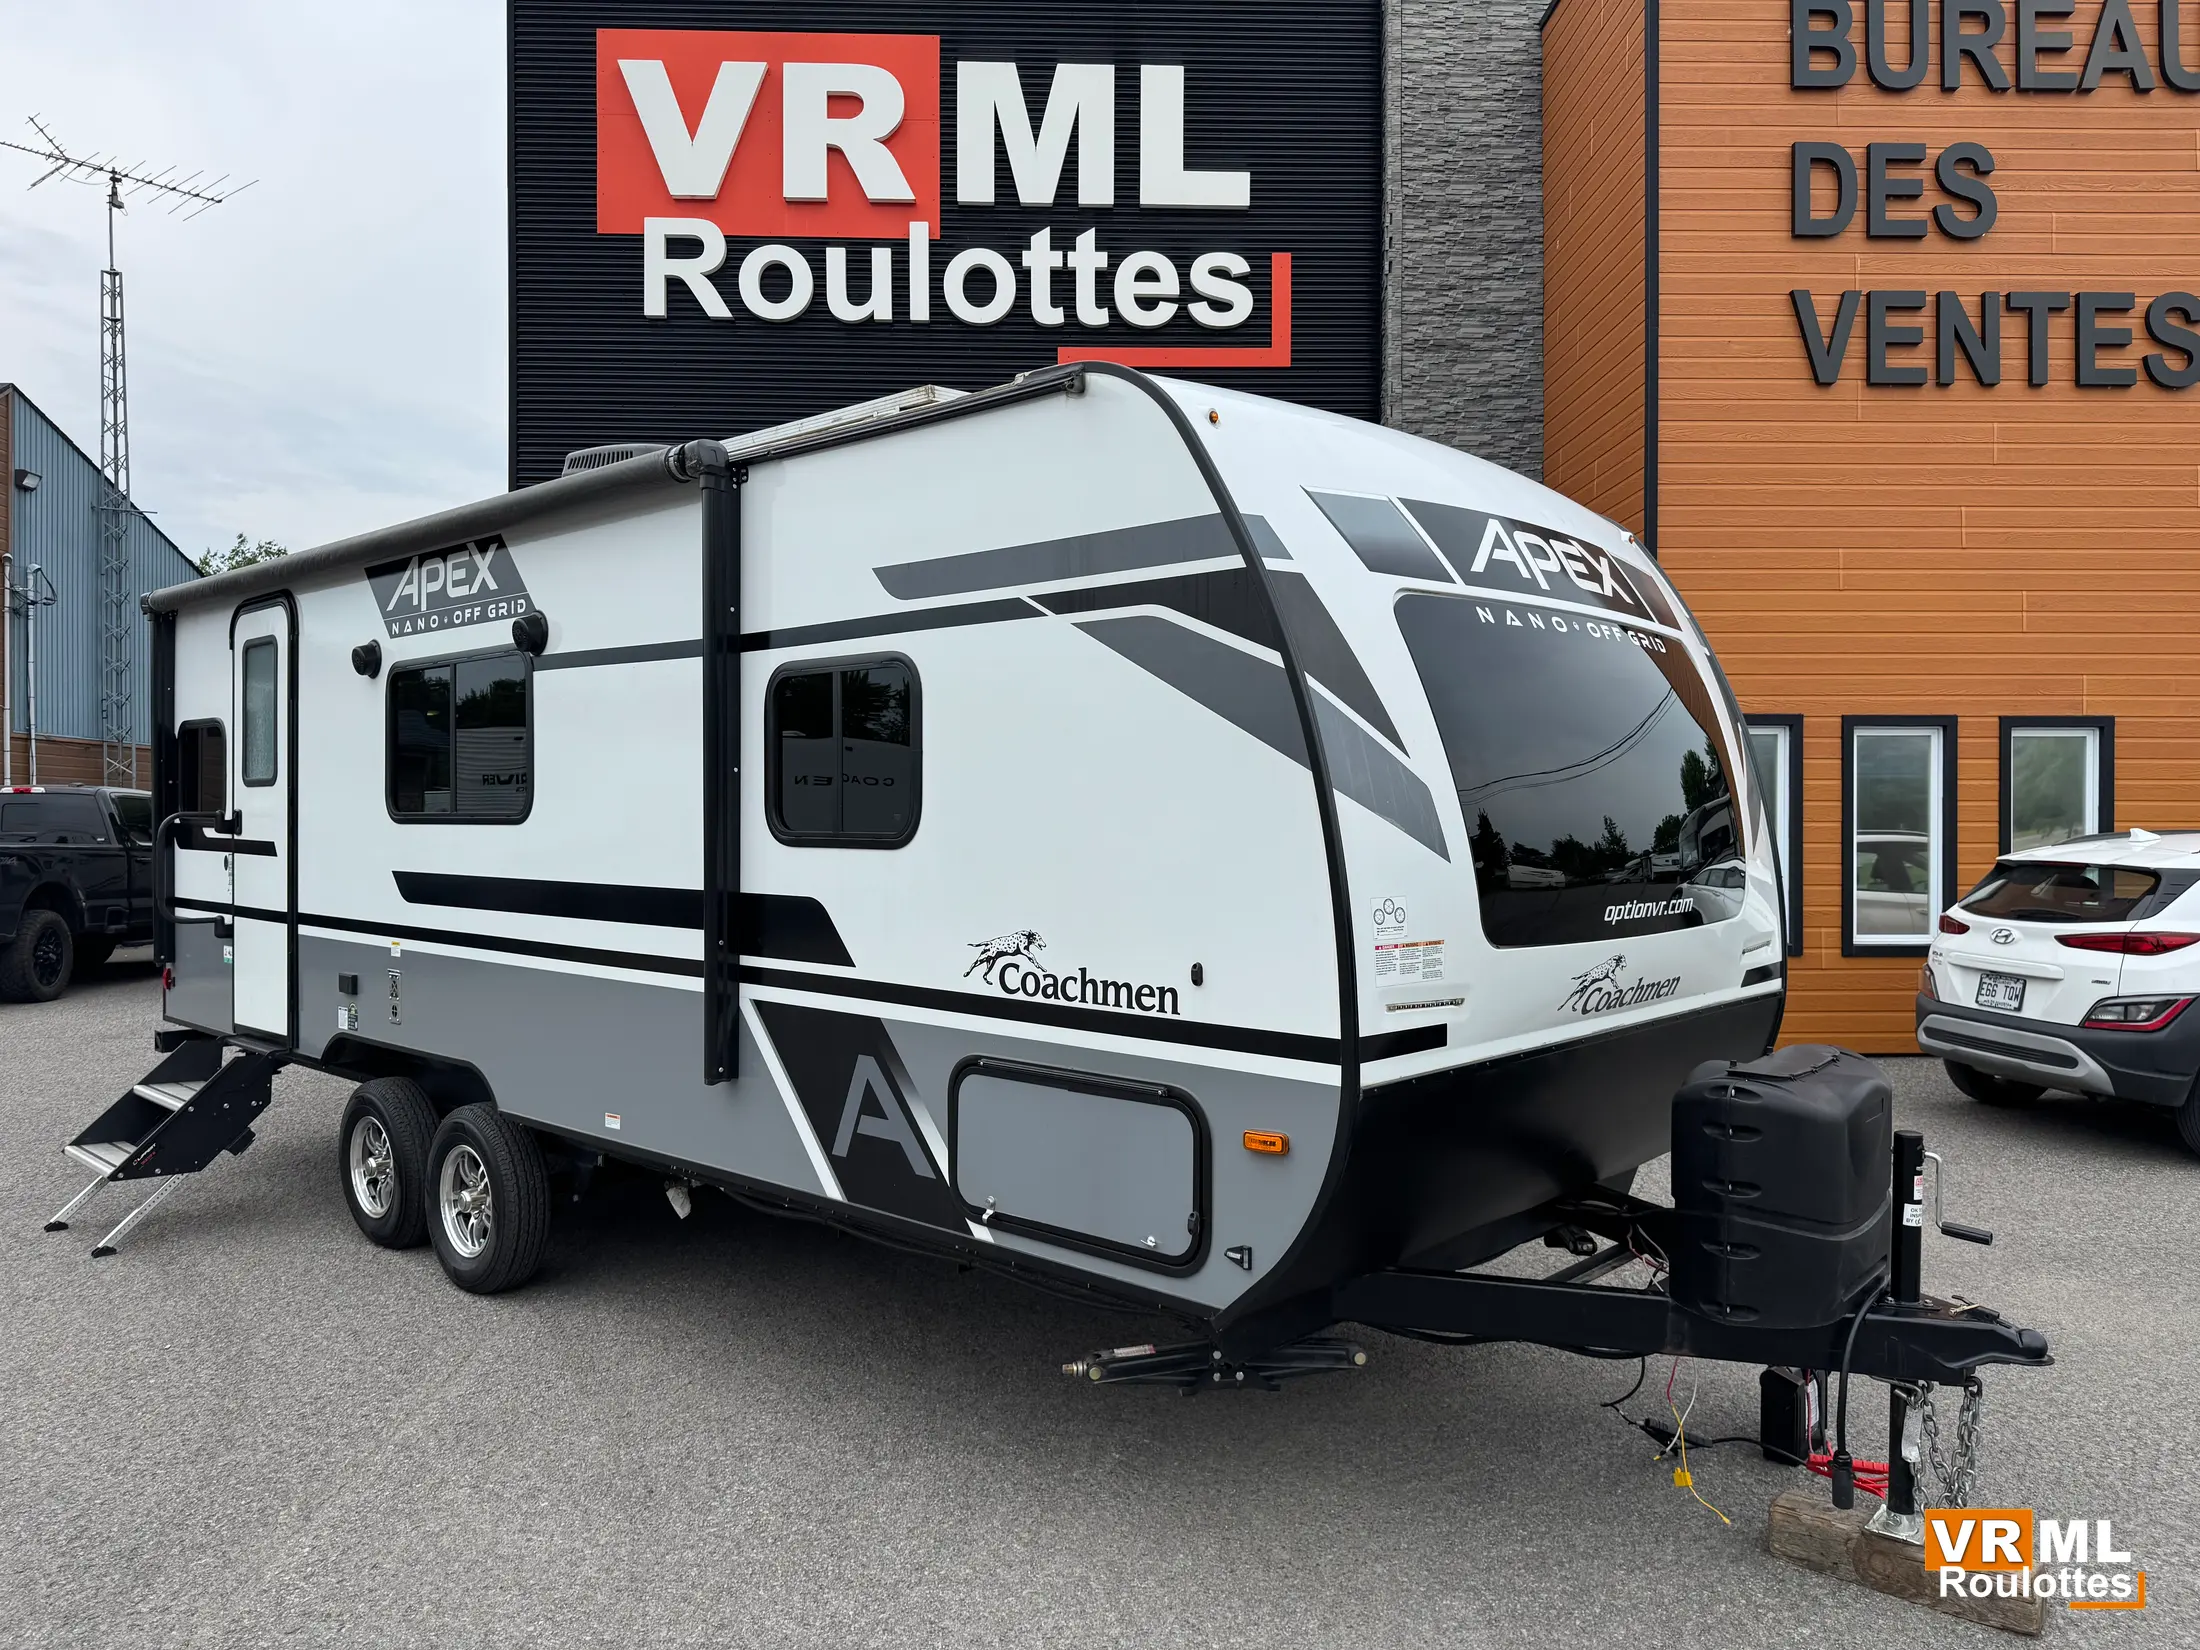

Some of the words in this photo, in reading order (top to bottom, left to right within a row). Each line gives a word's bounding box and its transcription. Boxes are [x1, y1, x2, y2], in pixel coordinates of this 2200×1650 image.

[1791, 141, 1998, 240] DES
[642, 217, 1254, 328] Roulottes
[1789, 289, 2200, 390] VENTES
[386, 541, 498, 611] APEX
[1470, 518, 1633, 604] APEX
[392, 615, 439, 635] NANO
[453, 606, 481, 625] OFF
[487, 598, 527, 618] GRID
[1475, 606, 1568, 633] NANO
[1586, 622, 1622, 642] OFF
[1627, 630, 1667, 653] GRID
[1604, 897, 1694, 925] optionvr.com
[999, 962, 1181, 1016] Coachmen
[1581, 975, 1681, 1015] Coachmen
